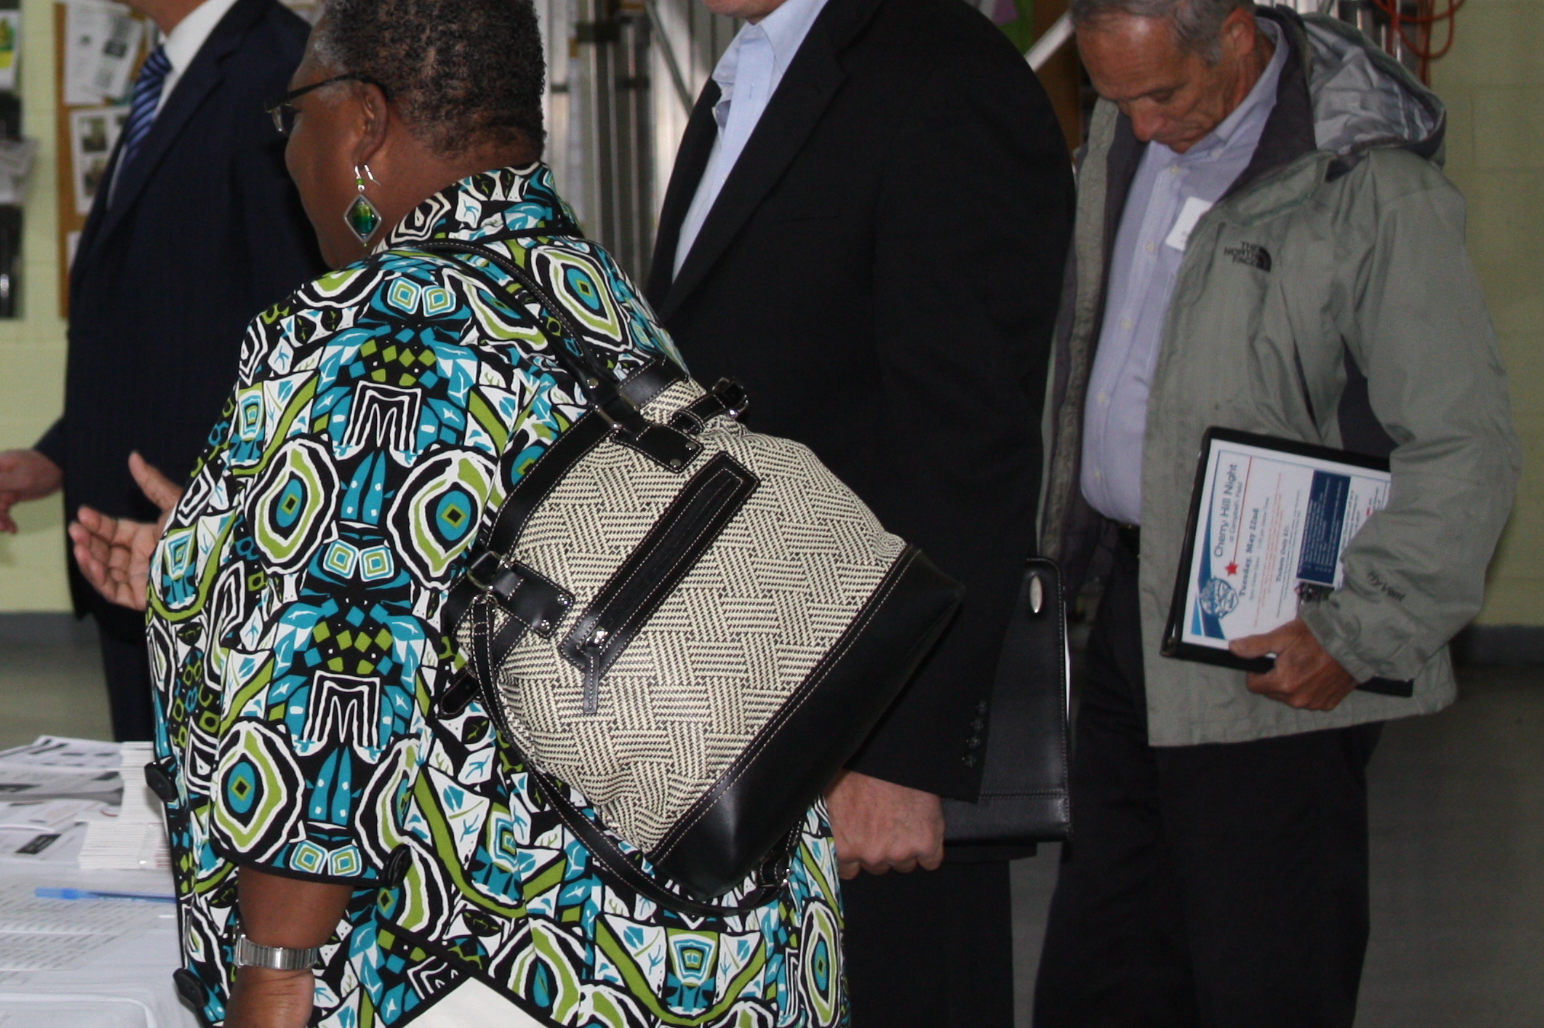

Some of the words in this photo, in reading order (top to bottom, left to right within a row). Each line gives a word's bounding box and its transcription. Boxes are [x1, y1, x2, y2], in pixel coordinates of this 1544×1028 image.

[1224, 463, 1238, 496] Night
[1220, 497, 1231, 518] Hill
[1214, 520, 1230, 558] Cherry
[1246, 533, 1256, 553] May
